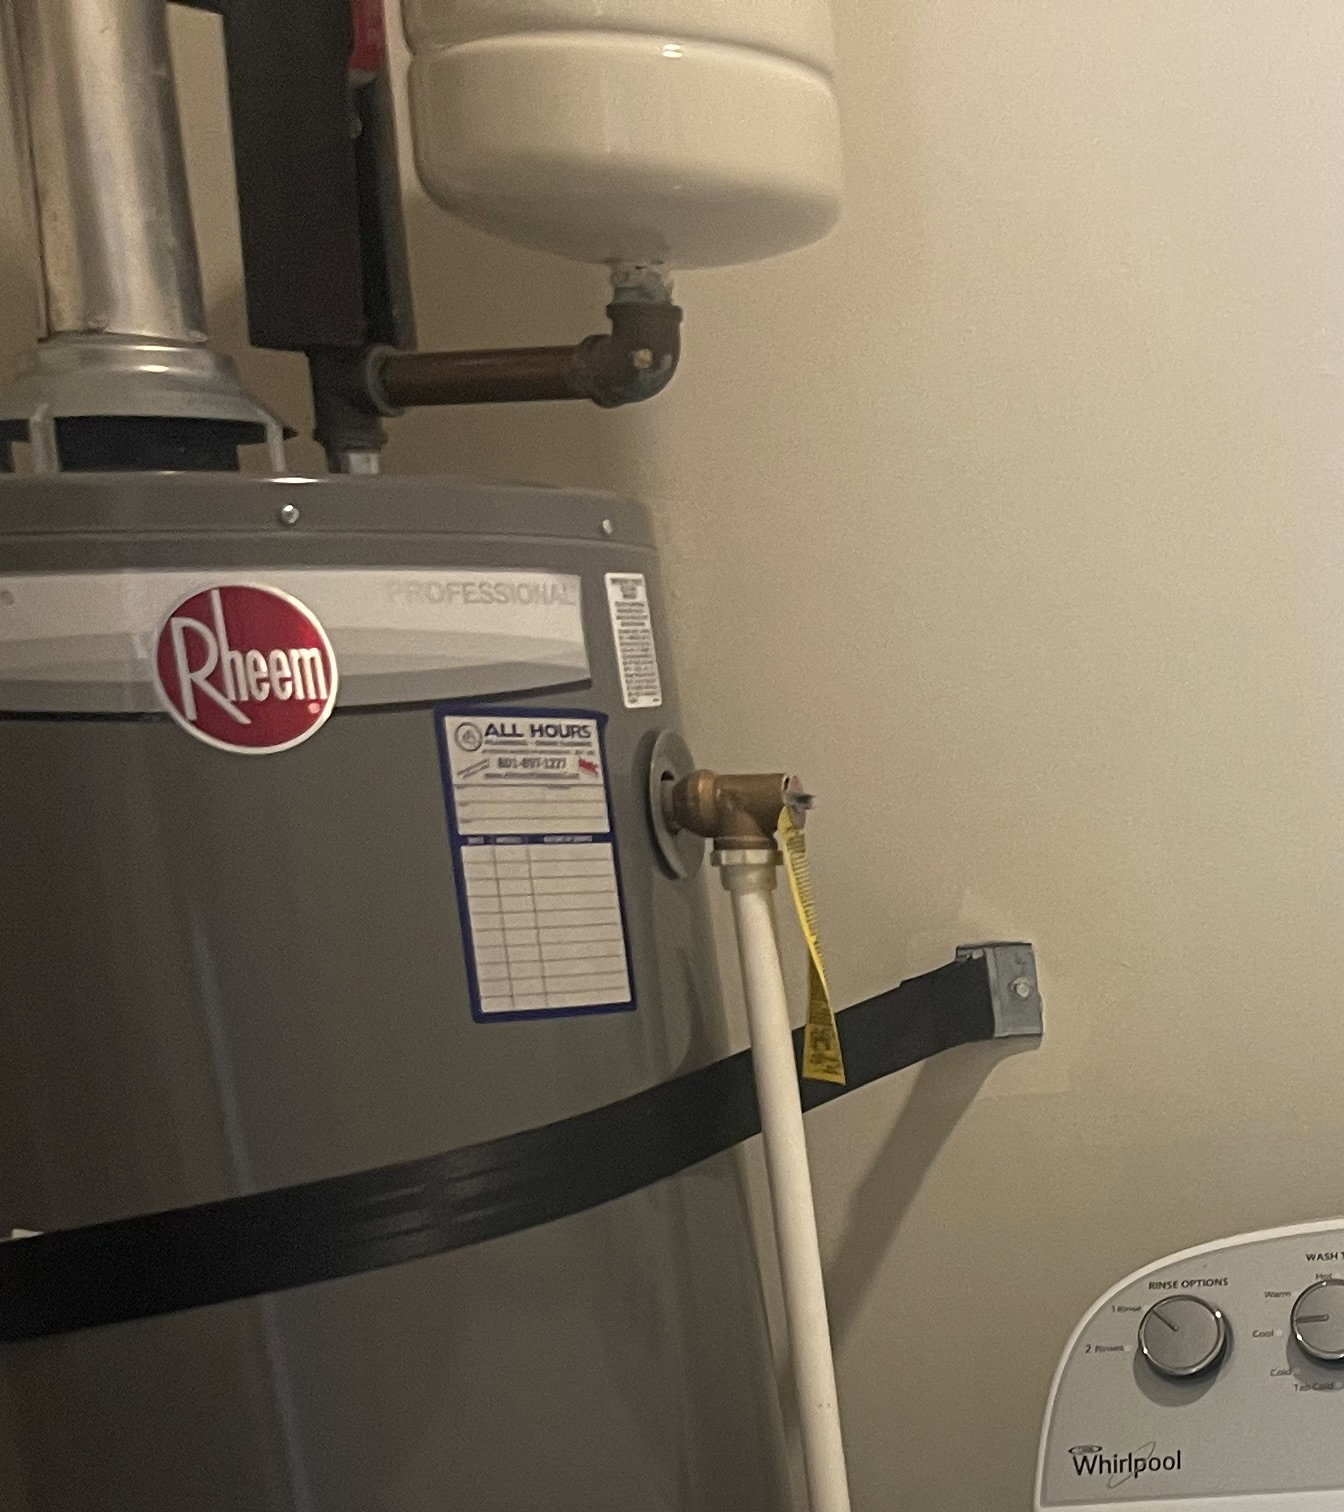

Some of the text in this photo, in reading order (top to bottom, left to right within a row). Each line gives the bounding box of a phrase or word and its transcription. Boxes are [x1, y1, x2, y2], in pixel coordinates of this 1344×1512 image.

[171, 589, 328, 725] Rheem
[484, 723, 591, 739] ALL HOURS
[1306, 1251, 1338, 1262] WASH
[1148, 1277, 1229, 1290] RINSE OPTIONS
[1252, 1329, 1274, 1338] Cool
[1085, 1344, 1091, 1353] 2
[1270, 1368, 1292, 1377] Cold
[1072, 1449, 1181, 1480] Whirlpool
